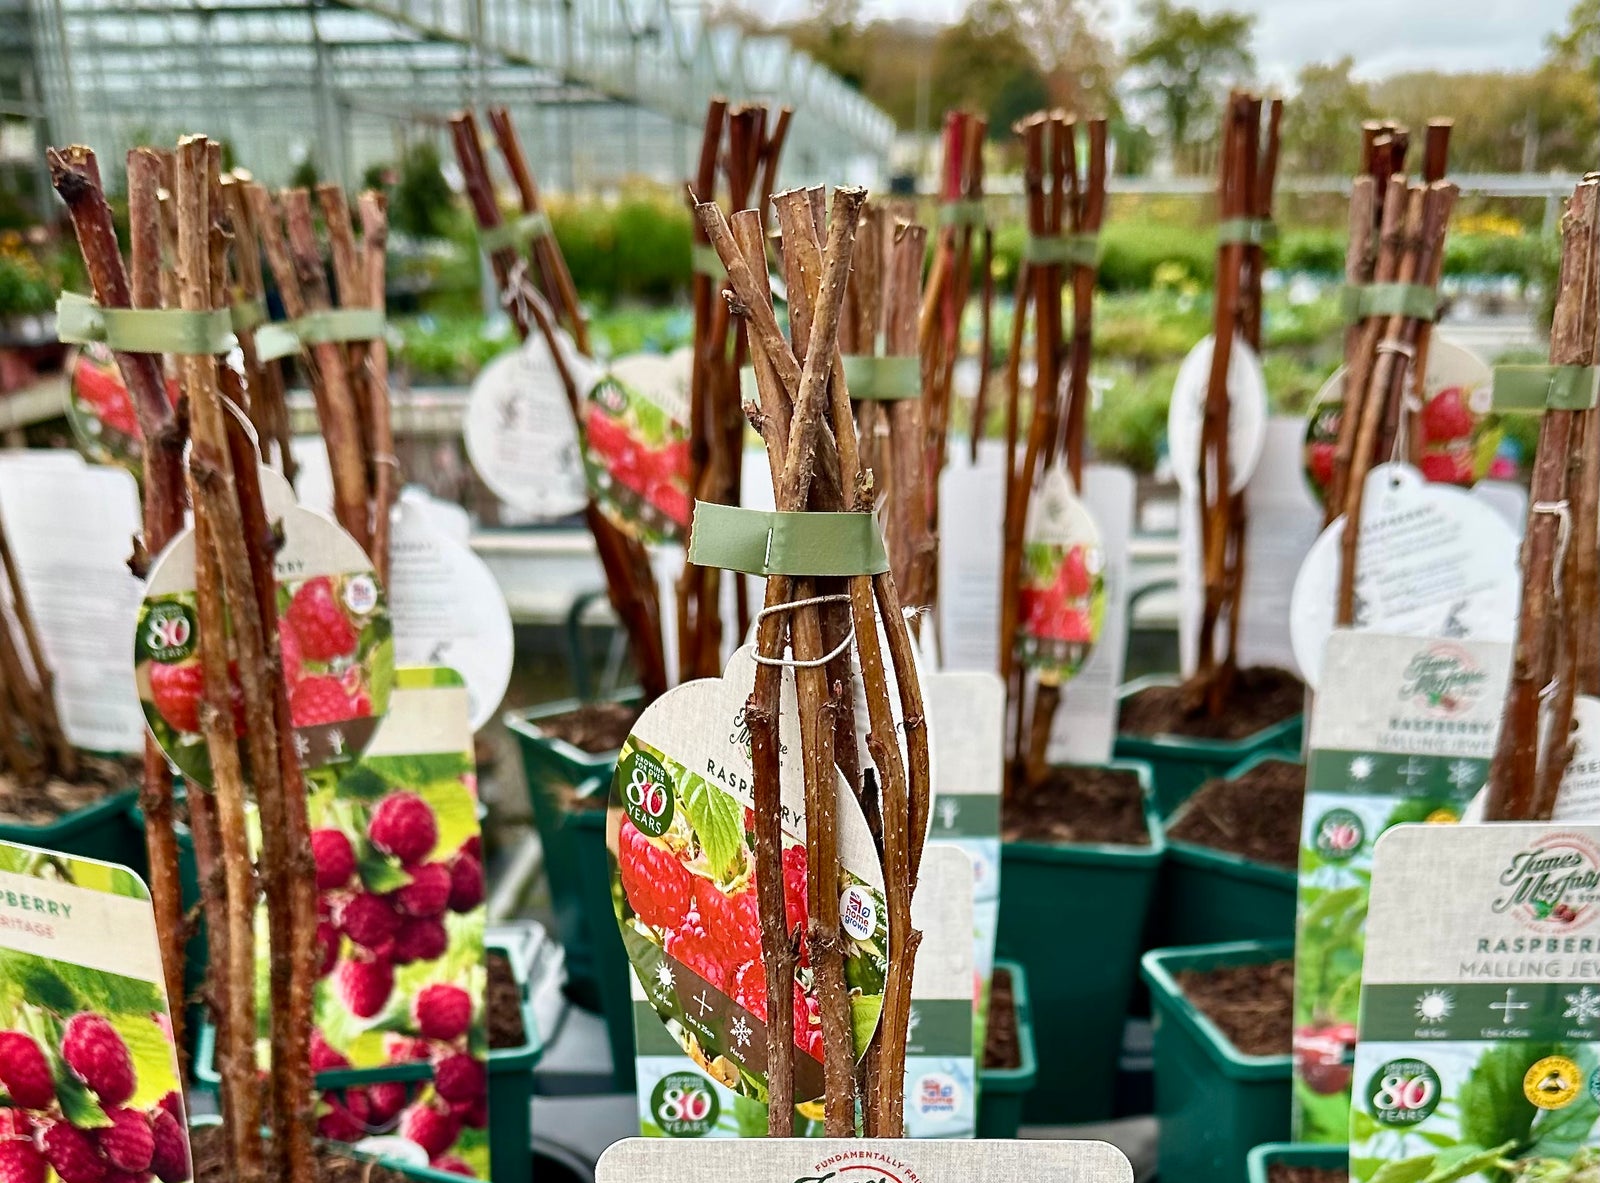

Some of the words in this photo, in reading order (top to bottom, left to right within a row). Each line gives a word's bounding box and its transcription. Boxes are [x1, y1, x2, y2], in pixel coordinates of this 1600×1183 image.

[626, 768, 667, 817] 80
[628, 803, 662, 834] YEARS
[844, 915, 868, 935] grown
[846, 905, 869, 927] home
[1477, 938, 1600, 953] RASPBER
[658, 1089, 712, 1120] 80
[1373, 1073, 1435, 1109] 80
[814, 1150, 904, 1173] FUNDAMENTALLY
